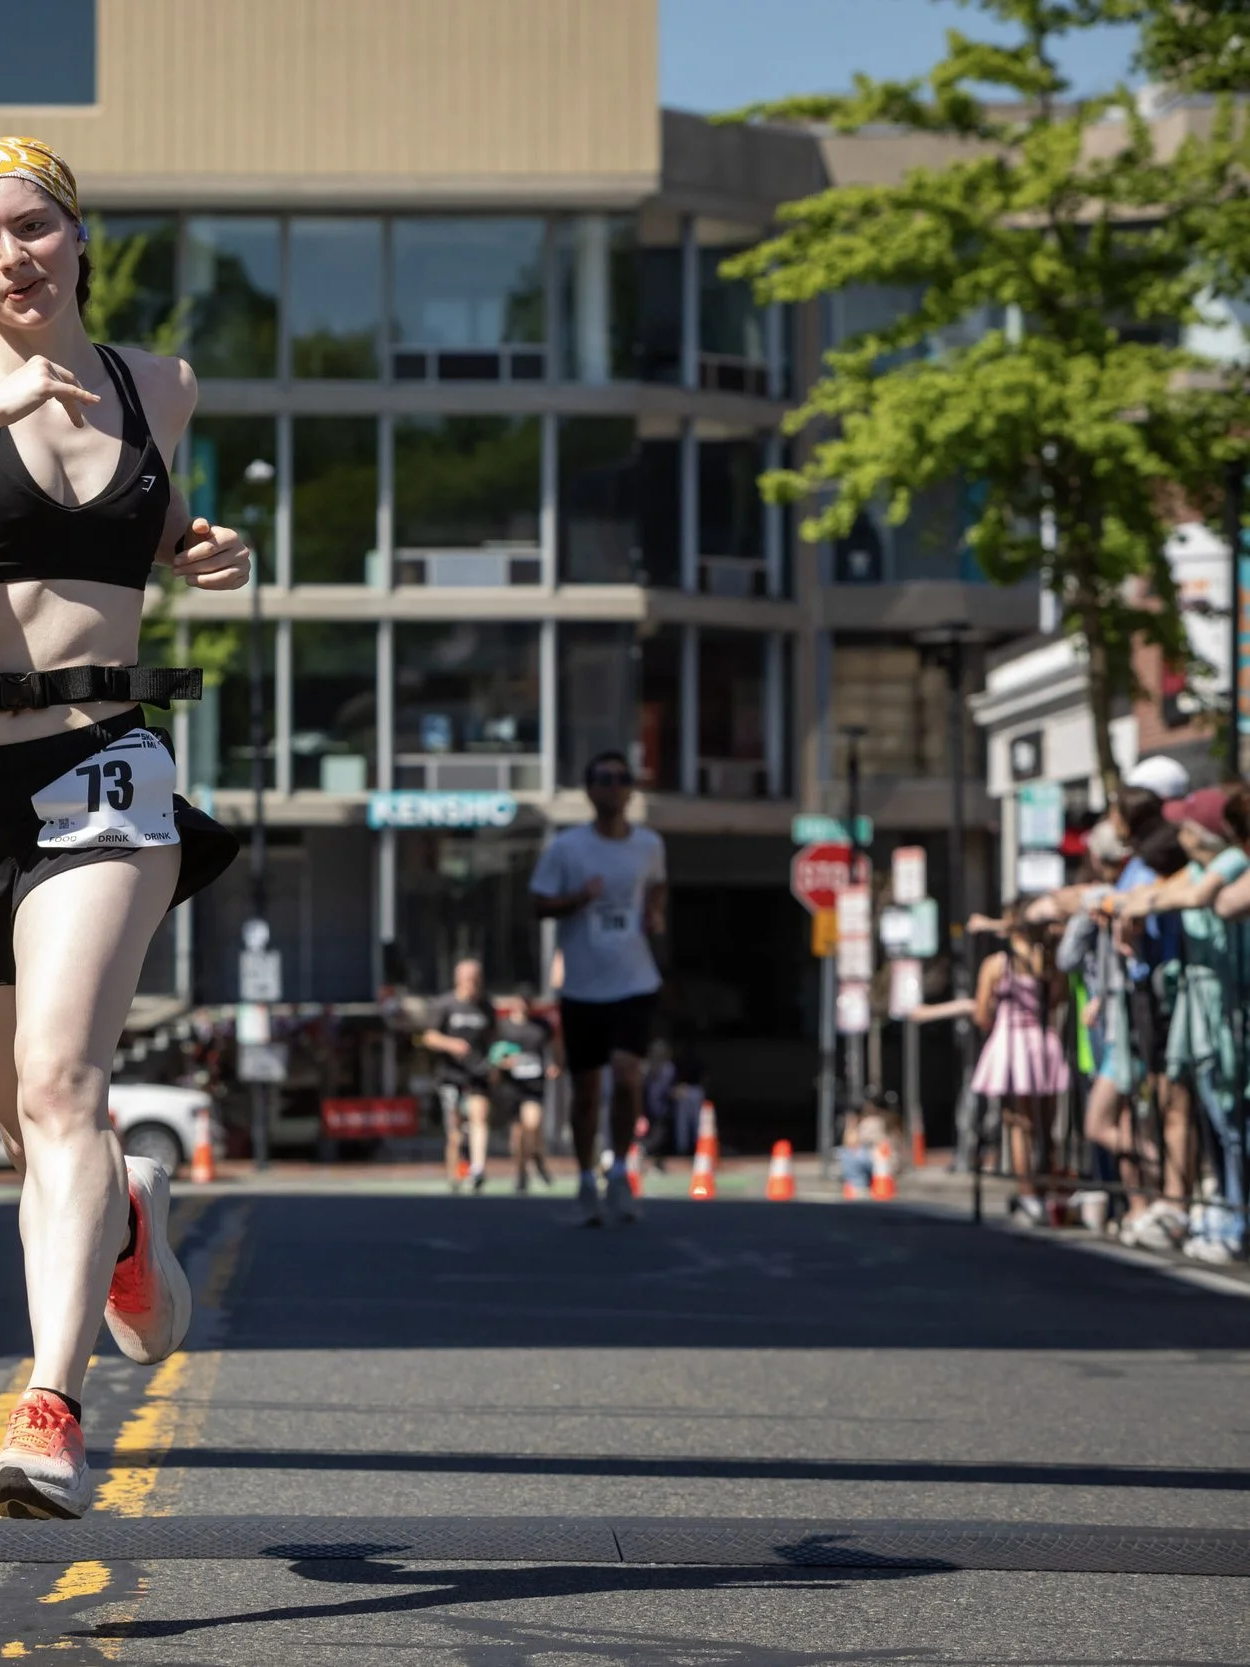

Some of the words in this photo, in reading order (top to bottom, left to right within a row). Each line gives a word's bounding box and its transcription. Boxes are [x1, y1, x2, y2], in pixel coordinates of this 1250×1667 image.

[76, 760, 134, 813] 73
[98, 834, 129, 843] DRINK
[144, 832, 172, 841] DRINK
